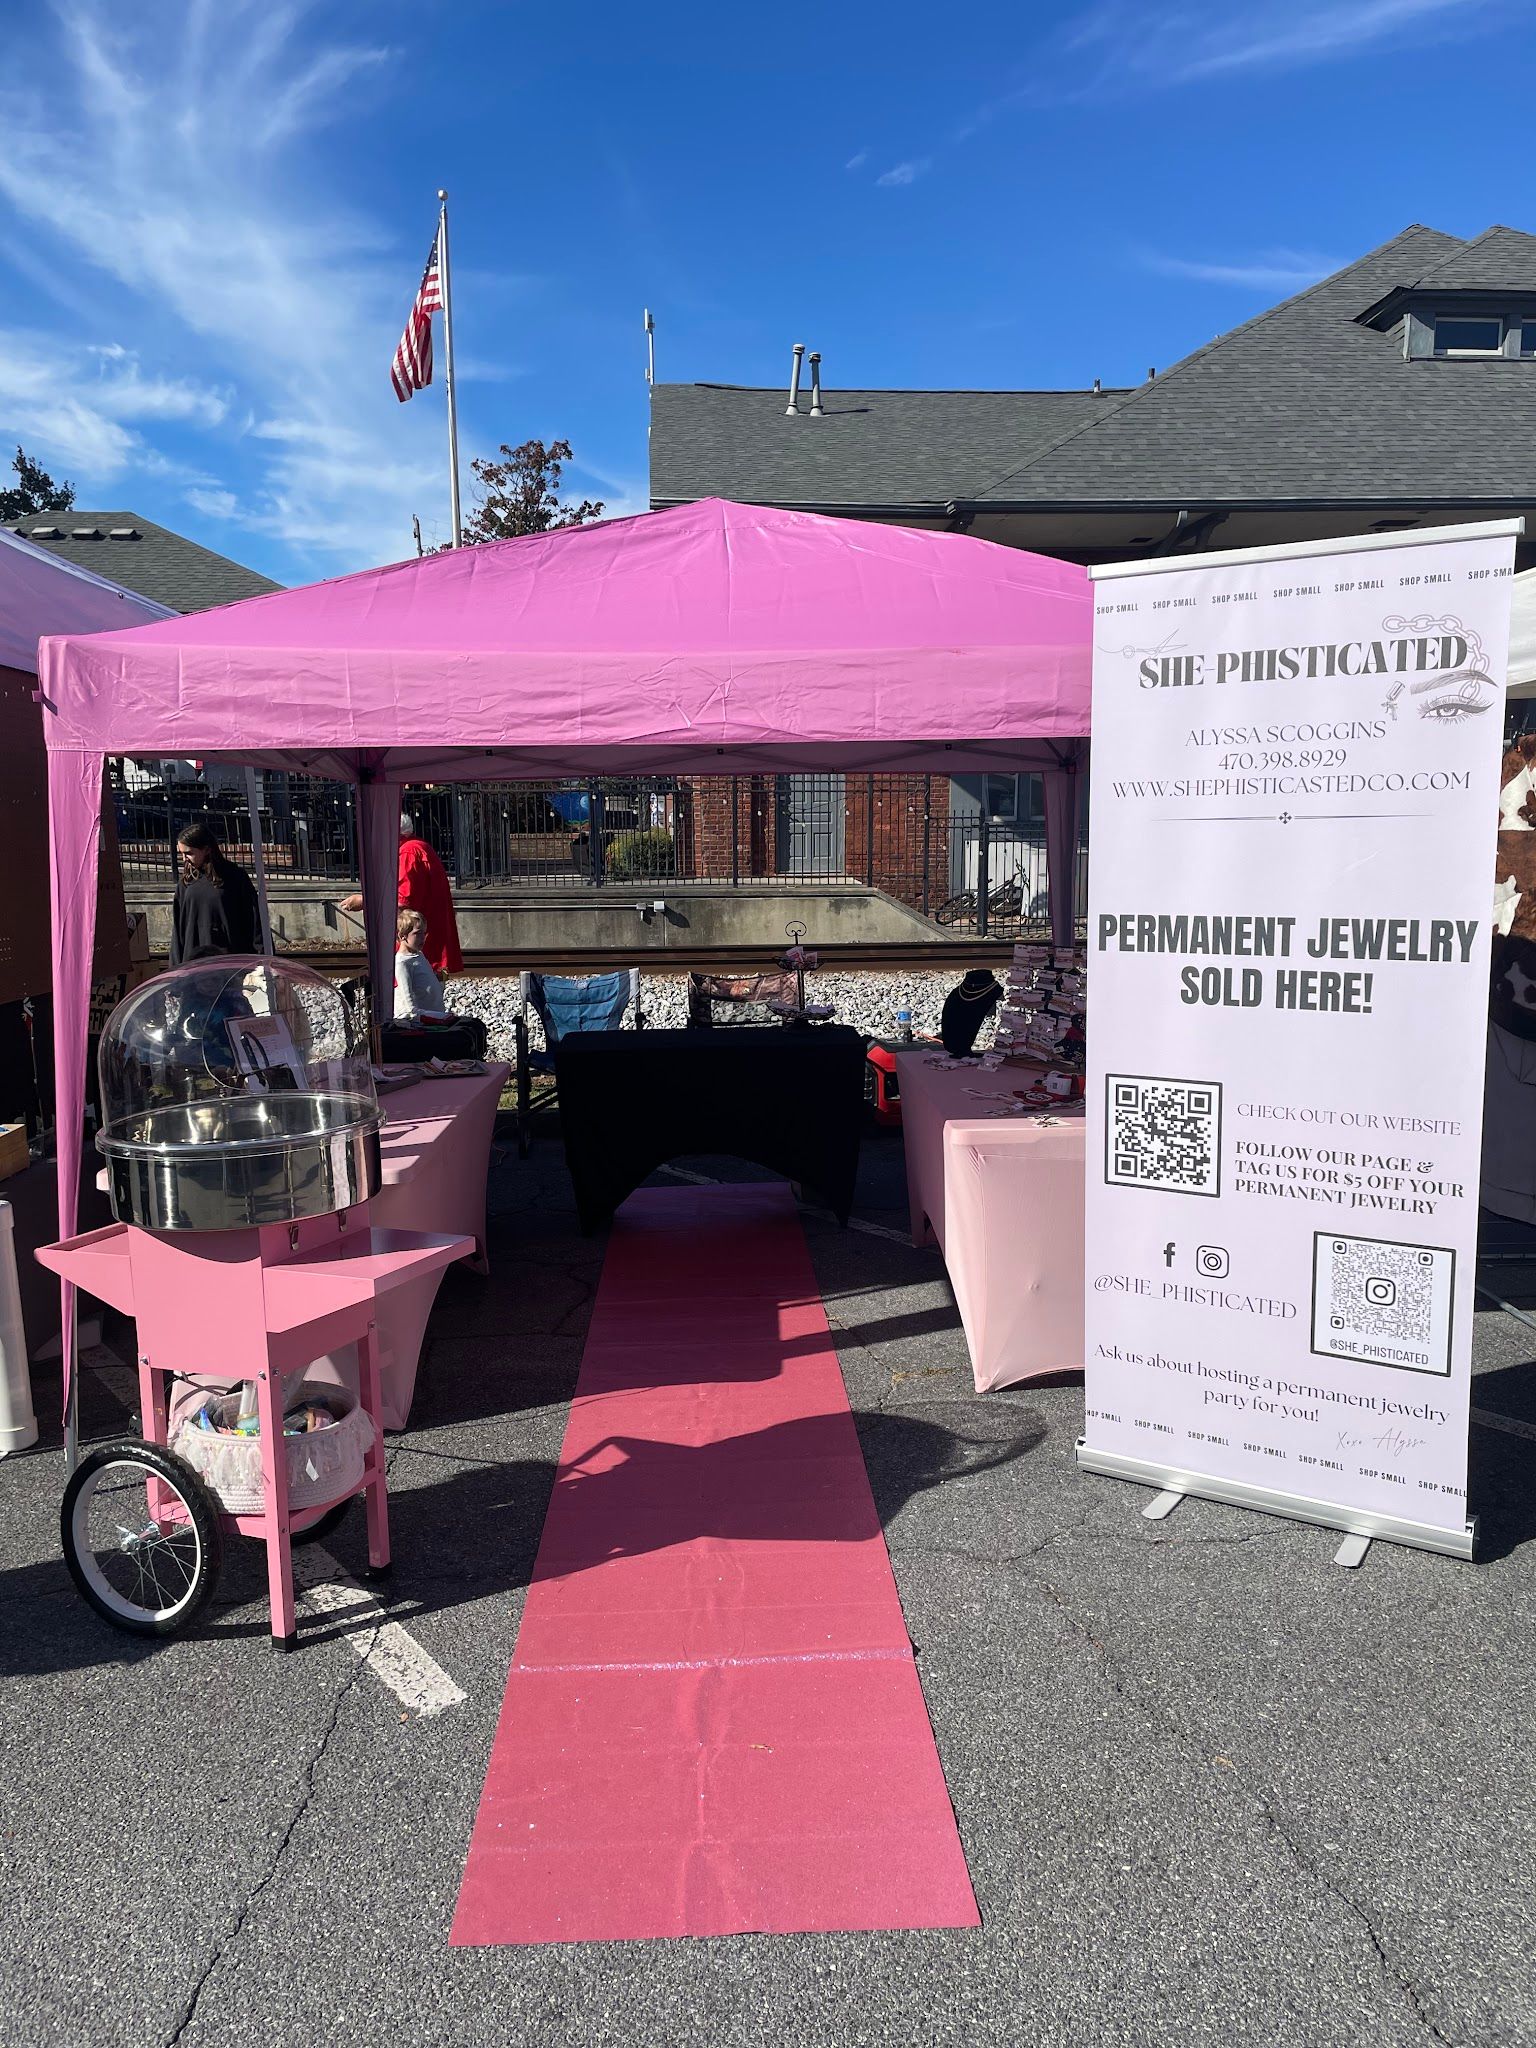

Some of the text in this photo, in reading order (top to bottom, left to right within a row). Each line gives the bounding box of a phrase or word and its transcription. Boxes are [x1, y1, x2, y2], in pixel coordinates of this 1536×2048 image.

[1097, 606, 1114, 615] SHOP
[1116, 603, 1139, 613] SMALL
[1152, 600, 1171, 609] SHOP
[1173, 597, 1197, 608] SMALL
[1212, 594, 1231, 604] SHOP
[1233, 591, 1258, 602] SMALL
[1273, 588, 1293, 598] SHOP
[1296, 586, 1321, 596] SMALL
[1334, 582, 1355, 592] SHOP
[1358, 579, 1384, 590] SMALL
[1399, 576, 1420, 587] SHOP
[1424, 573, 1451, 584] SMALL
[1468, 569, 1490, 580] SHOP
[1139, 635, 1469, 689] SHE-PHISTICATED
[1185, 720, 1387, 747] ALYSSA SCOGGINS
[1218, 749, 1347, 771] 470.398.8929
[1112, 771, 1471, 798] WWW.SHEPHISTICASTEDCO.COM
[1098, 913, 1479, 963] PERMANENT JEWELRY
[1180, 965, 1374, 1013] SOLD HERE!
[1237, 1103, 1461, 1136] CHECK OUT OUR WEBSITE
[1235, 1141, 1434, 1174] FOLLOW OUR PAGE &
[1235, 1160, 1465, 1198] TAG US FOR $5 OFF YOUR
[1235, 1178, 1438, 1215] PERMANENT JEWELRY
[1094, 1274, 1297, 1320] @SHE_PHISTICATED
[1329, 1338, 1430, 1366] @SHE_PHISTICATED
[1094, 1344, 1450, 1426] Ask us about hosting a permanent jewelry
[1204, 1390, 1319, 1422] party for you!
[1101, 1412, 1122, 1423] SMALL
[1134, 1419, 1151, 1429] SHOP
[1152, 1423, 1175, 1434] SMALL
[1187, 1431, 1205, 1441] SHOP
[1207, 1435, 1230, 1446] SMALL
[1243, 1443, 1261, 1453] SHOP
[1263, 1447, 1287, 1459] SMALL
[1299, 1454, 1317, 1465] SHOP
[1320, 1459, 1344, 1471] SMALL
[1359, 1467, 1378, 1478] SHOP
[1381, 1472, 1406, 1485] SMALL
[1418, 1480, 1439, 1491] SHOP
[1441, 1485, 1468, 1498] SMALL
